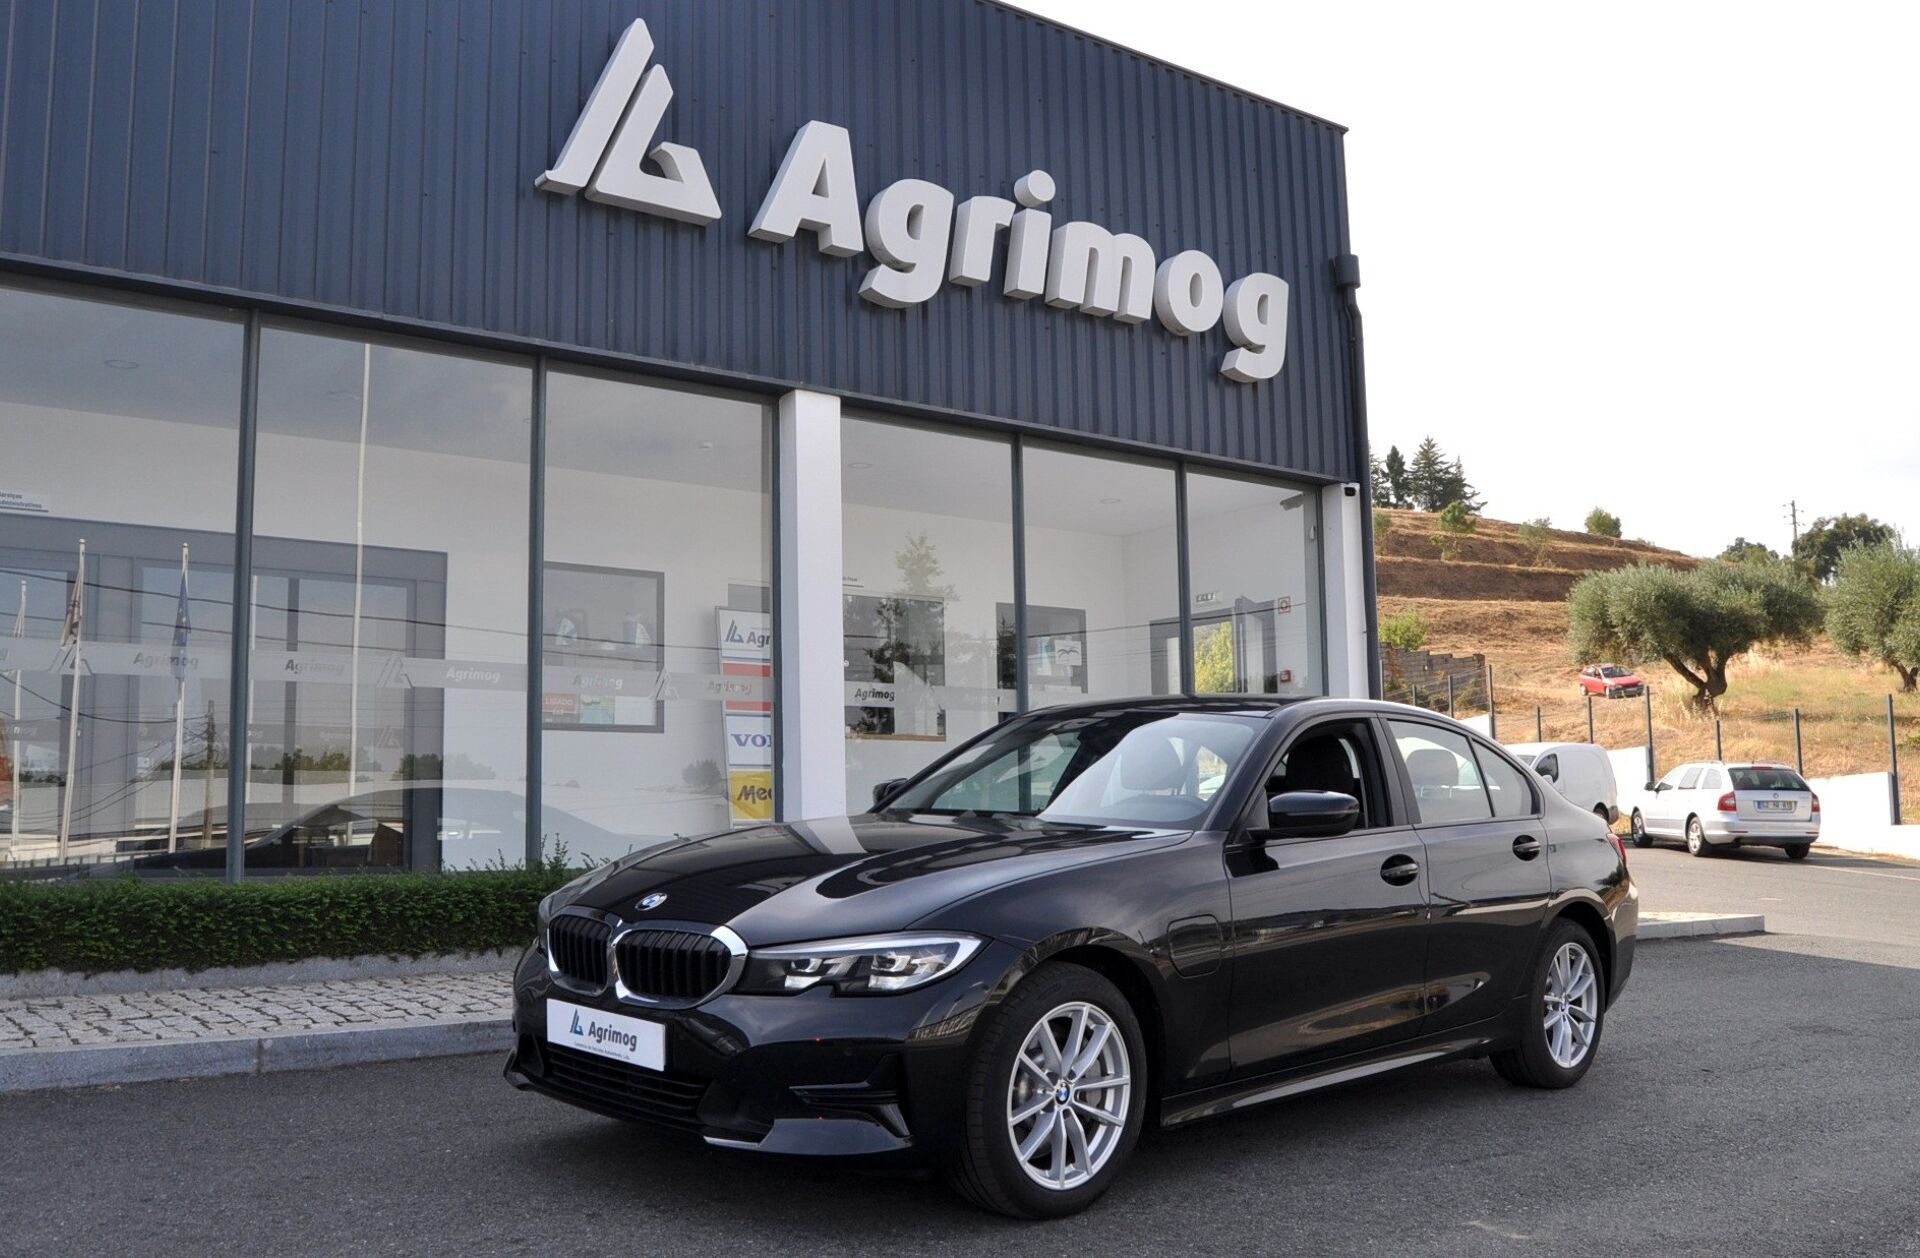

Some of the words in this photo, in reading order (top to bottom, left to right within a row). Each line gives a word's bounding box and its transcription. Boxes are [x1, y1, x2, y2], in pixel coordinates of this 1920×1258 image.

[747, 120, 1289, 384] Agrimog
[132, 651, 199, 669] Agrimog
[285, 658, 345, 675] Agrimog
[446, 667, 501, 684] Agrimog
[854, 688, 895, 702] Agrimog
[588, 1021, 637, 1052] Agrimog
